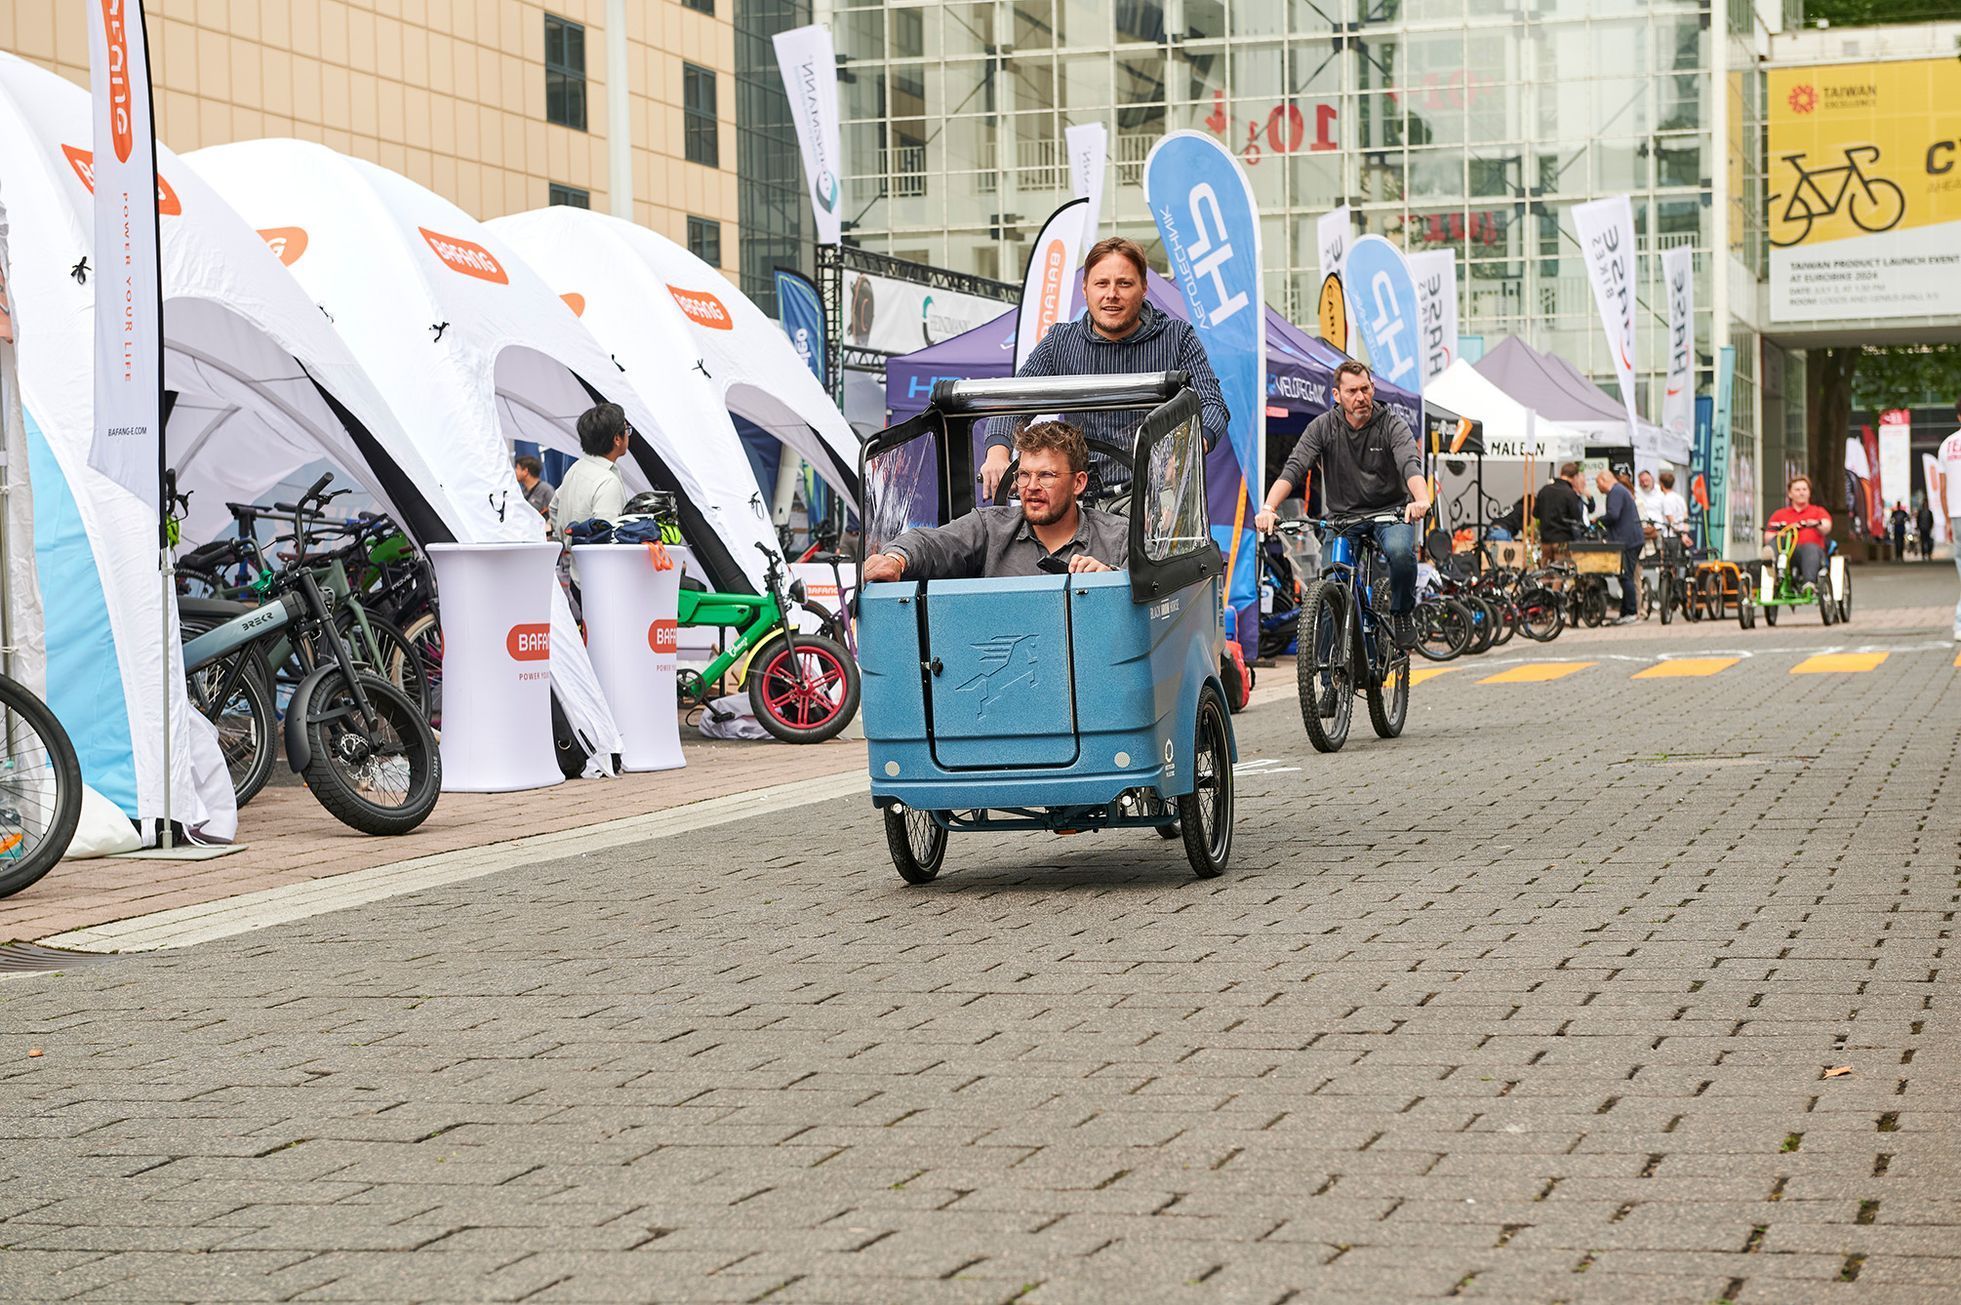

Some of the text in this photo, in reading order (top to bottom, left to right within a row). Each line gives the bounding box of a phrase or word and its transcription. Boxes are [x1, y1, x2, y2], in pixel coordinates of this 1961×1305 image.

[1823, 85, 1877, 98] TAIWAN
[122, 192, 132, 265] POWER
[430, 237, 498, 274] BAFANG
[1834, 258, 1880, 269] PRODUCT
[1883, 257, 1926, 268] LAUNCH
[1928, 254, 1961, 265] EVENT
[125, 276, 133, 332] YOUR
[673, 293, 725, 321] BAFANG
[108, 425, 147, 437] BAFANG-E.COM
[1491, 441, 1546, 457] MALEN
[241, 612, 275, 631] BREKR
[518, 632, 550, 652] BAFA
[518, 672, 540, 681] POWER
